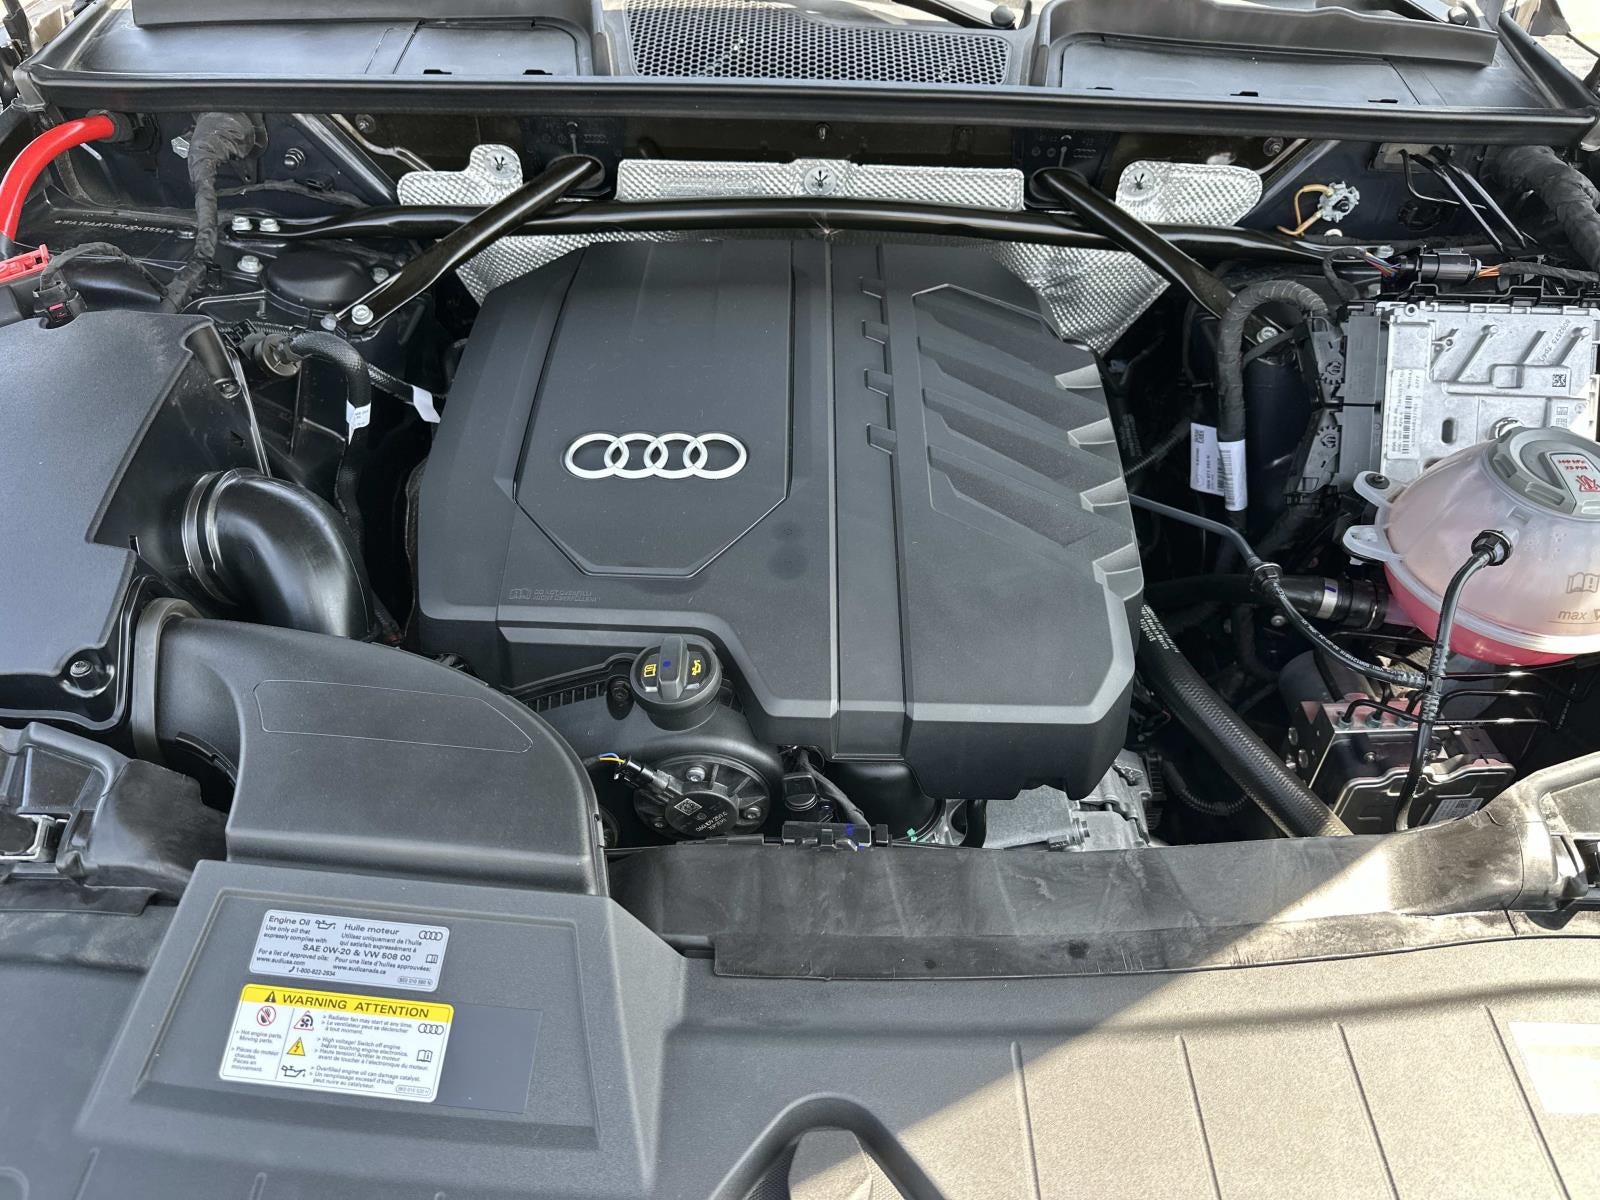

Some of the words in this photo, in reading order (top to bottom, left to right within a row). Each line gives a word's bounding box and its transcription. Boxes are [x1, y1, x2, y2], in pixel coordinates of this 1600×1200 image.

[1558, 610, 1587, 620] max
[268, 915, 297, 925] Engine
[299, 918, 310, 926] Oil
[277, 926, 290, 934] only
[344, 923, 366, 932] Huile
[367, 926, 400, 935] moteur
[258, 948, 268, 956] For
[290, 951, 316, 960] approved
[302, 944, 322, 952] SAE
[322, 946, 351, 956] 0W-20
[364, 950, 380, 958] VW
[382, 952, 398, 960] 508
[400, 954, 412, 962] 00
[256, 956, 306, 966] www.audiusa.com
[333, 964, 386, 974] www.audicanada.ca
[283, 994, 348, 1010] WARNING
[354, 1002, 429, 1018] ATTENTION
